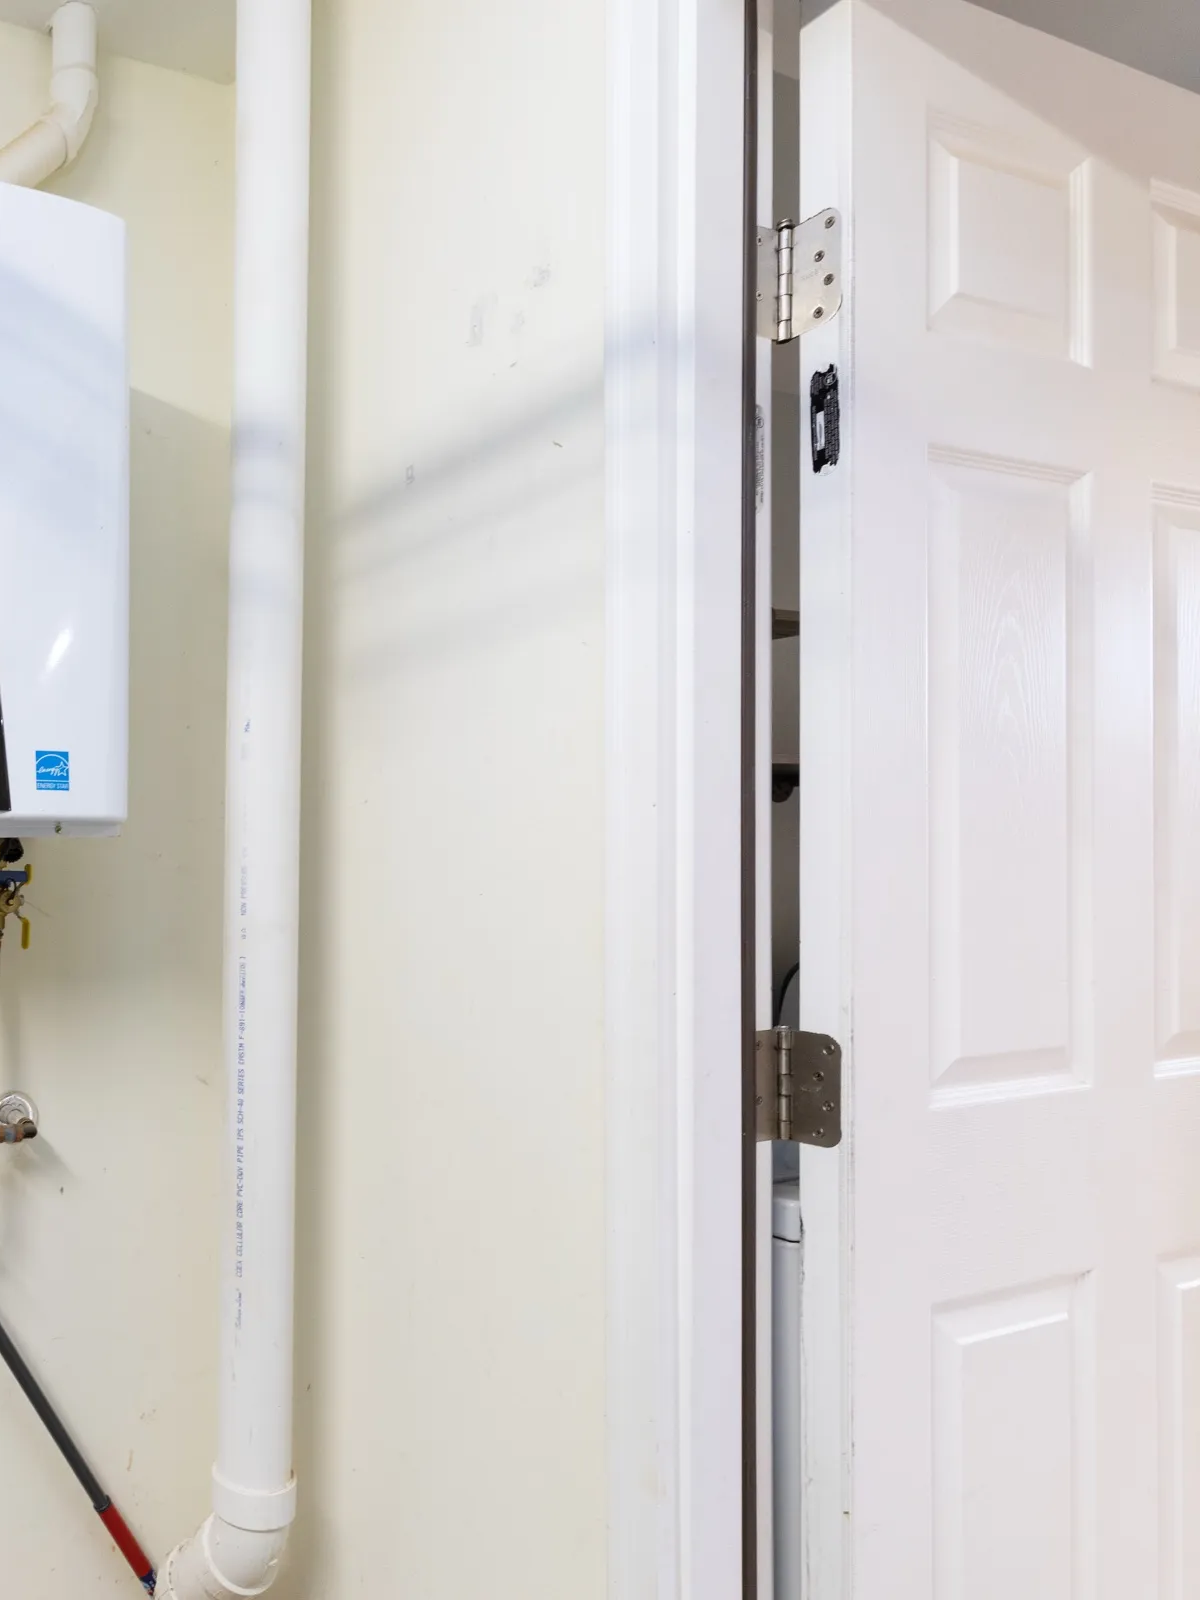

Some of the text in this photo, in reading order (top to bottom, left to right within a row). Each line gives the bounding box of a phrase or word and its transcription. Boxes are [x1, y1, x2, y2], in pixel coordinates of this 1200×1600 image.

[237, 1068, 245, 1095] SERIES
[236, 1098, 245, 1125] SCH-40
[236, 1128, 244, 1141] IPS
[236, 1145, 244, 1163] PIPE
[235, 1200, 244, 1219] CORE
